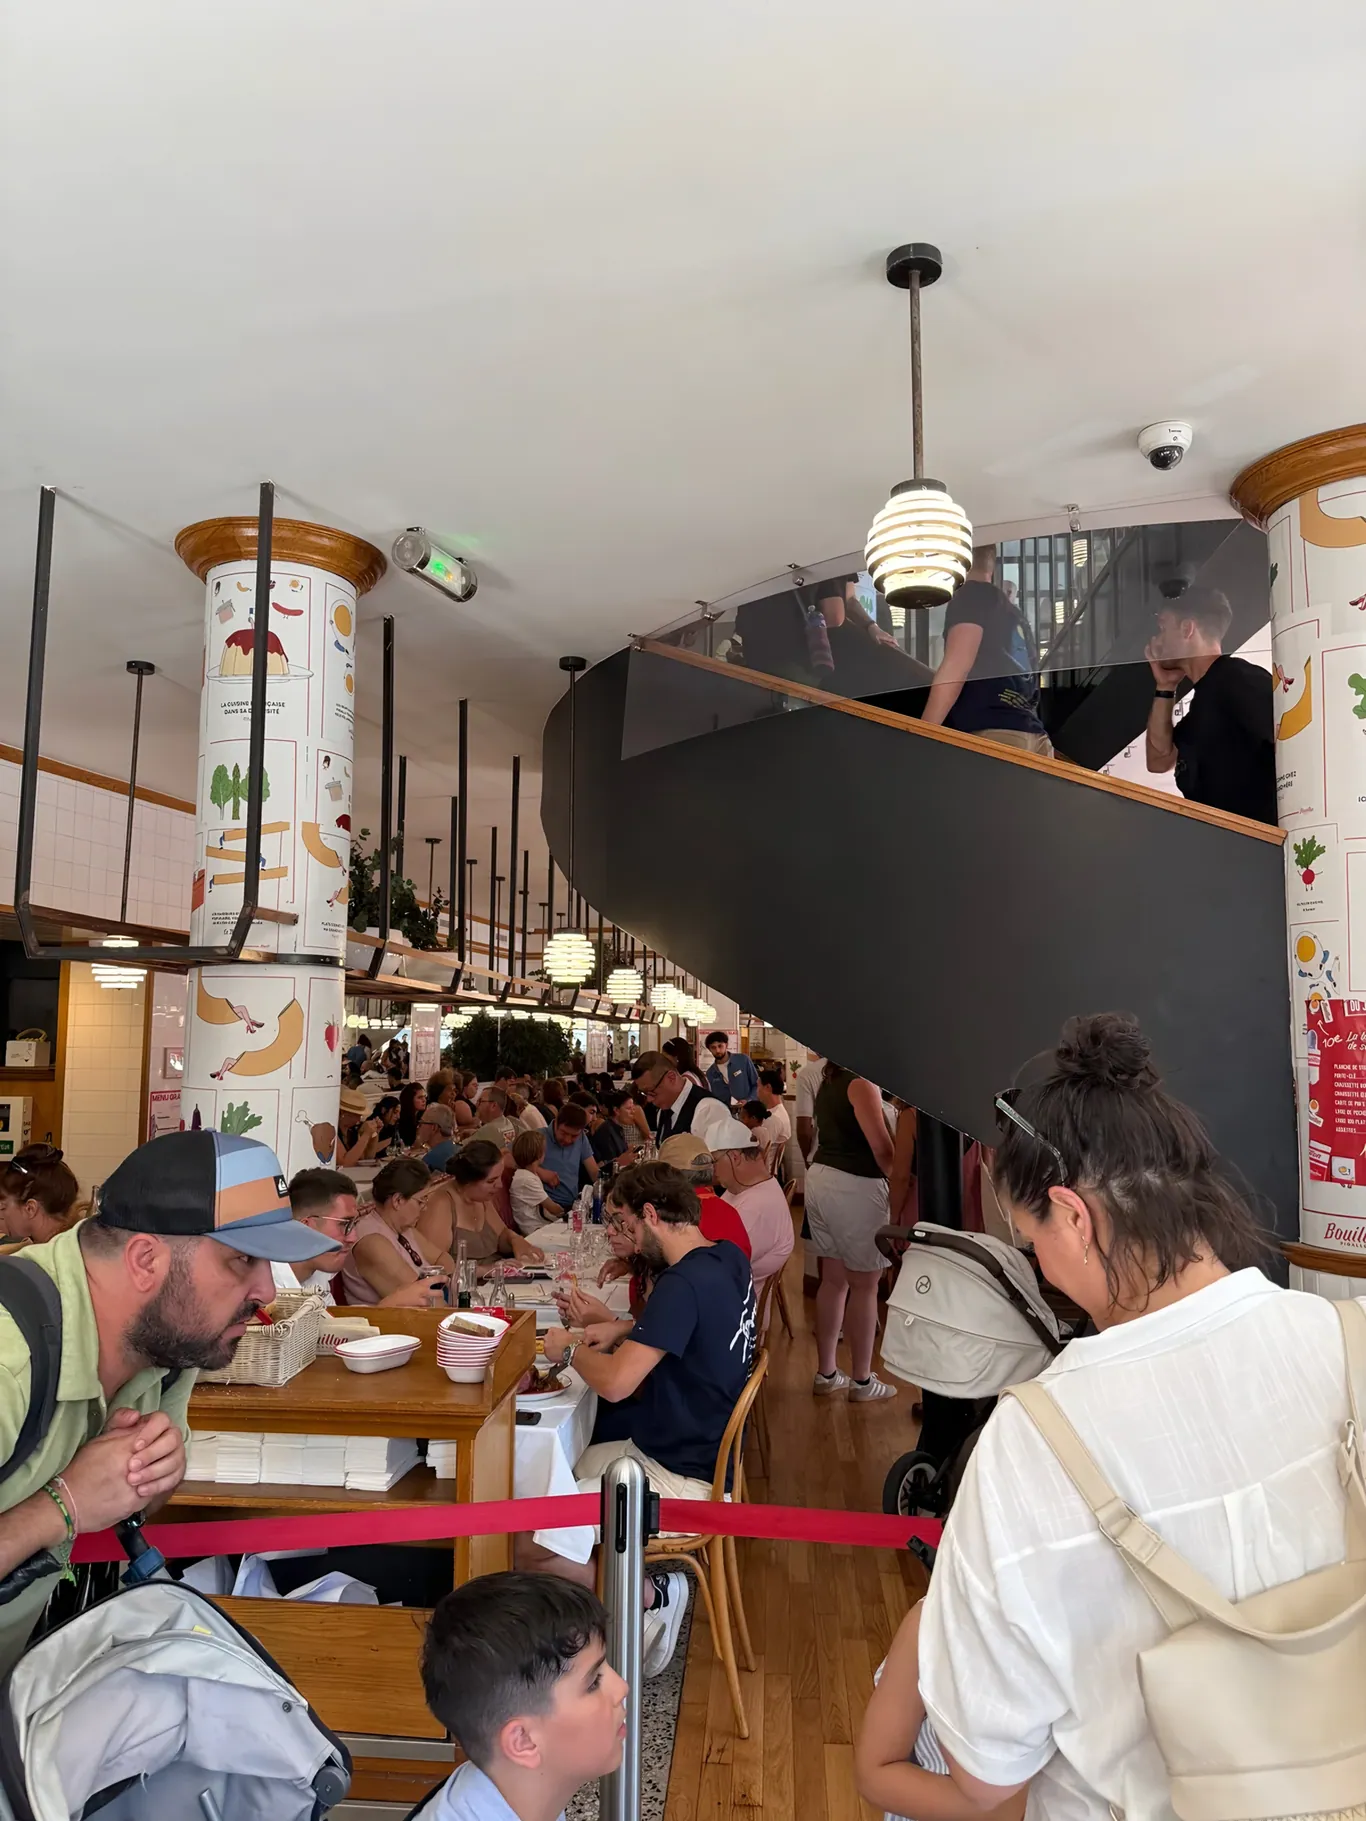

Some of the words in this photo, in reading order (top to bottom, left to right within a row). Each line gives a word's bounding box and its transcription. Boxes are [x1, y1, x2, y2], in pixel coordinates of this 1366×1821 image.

[1322, 1034, 1343, 1048] 10€
[1346, 1032, 1358, 1042] La
[1347, 1042, 1358, 1050] de
[152, 1094, 168, 1102] MENU
[170, 1093, 181, 1101] GRA
